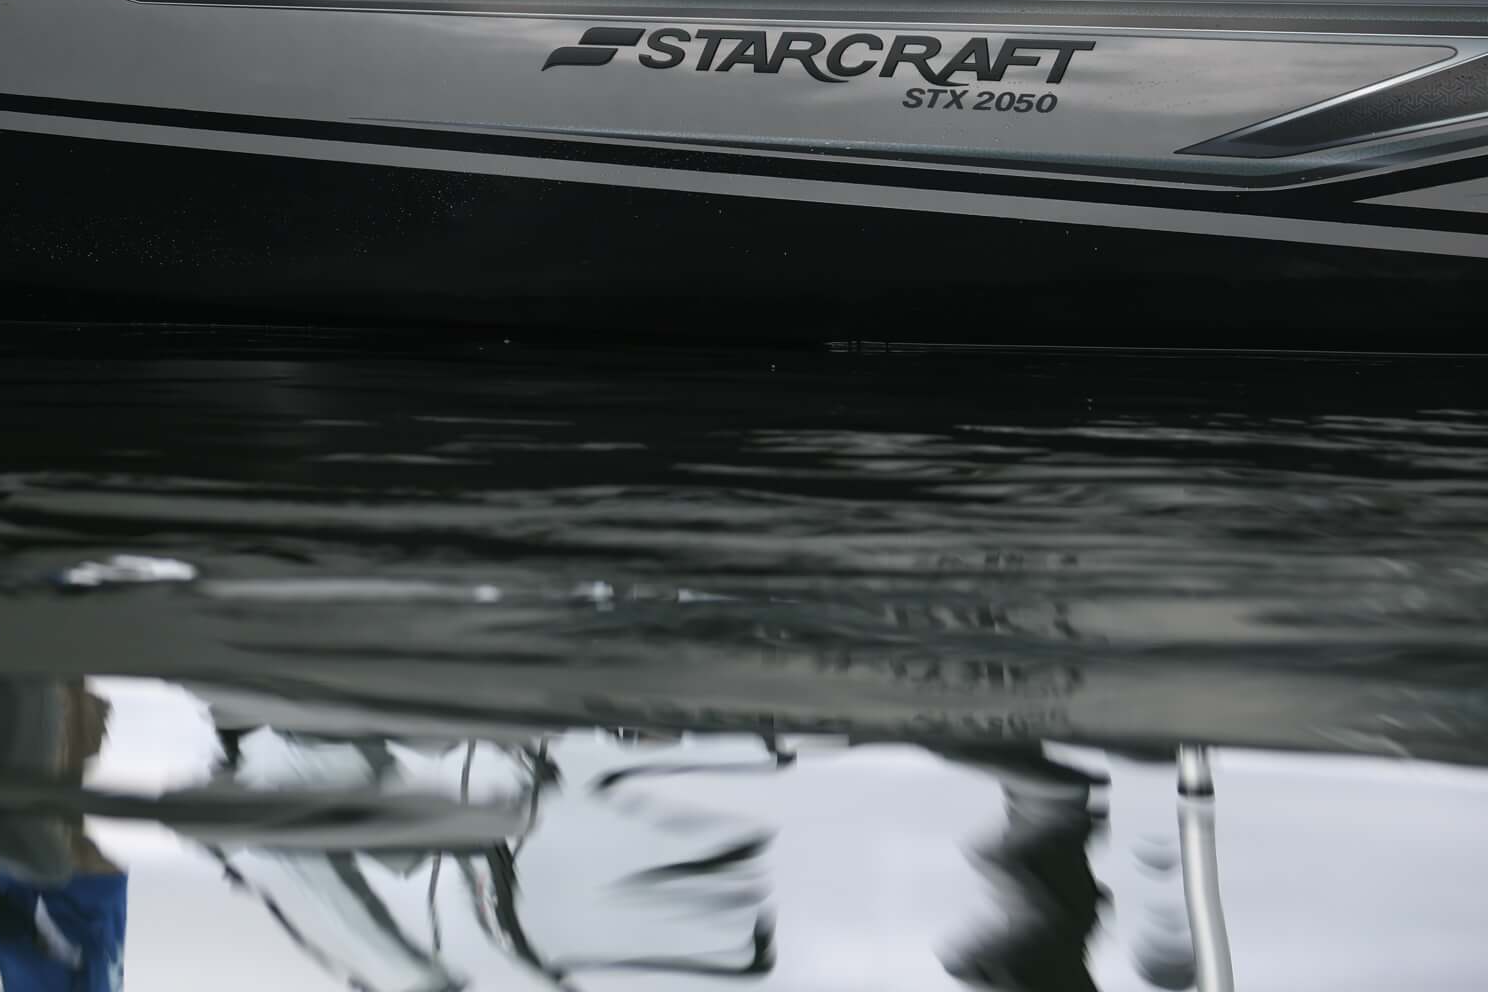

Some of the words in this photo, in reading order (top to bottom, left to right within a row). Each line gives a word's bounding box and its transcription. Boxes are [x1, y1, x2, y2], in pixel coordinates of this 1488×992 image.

[638, 28, 1097, 87] STARCRAFT
[902, 88, 969, 109] STX
[973, 91, 1058, 113] 2050
